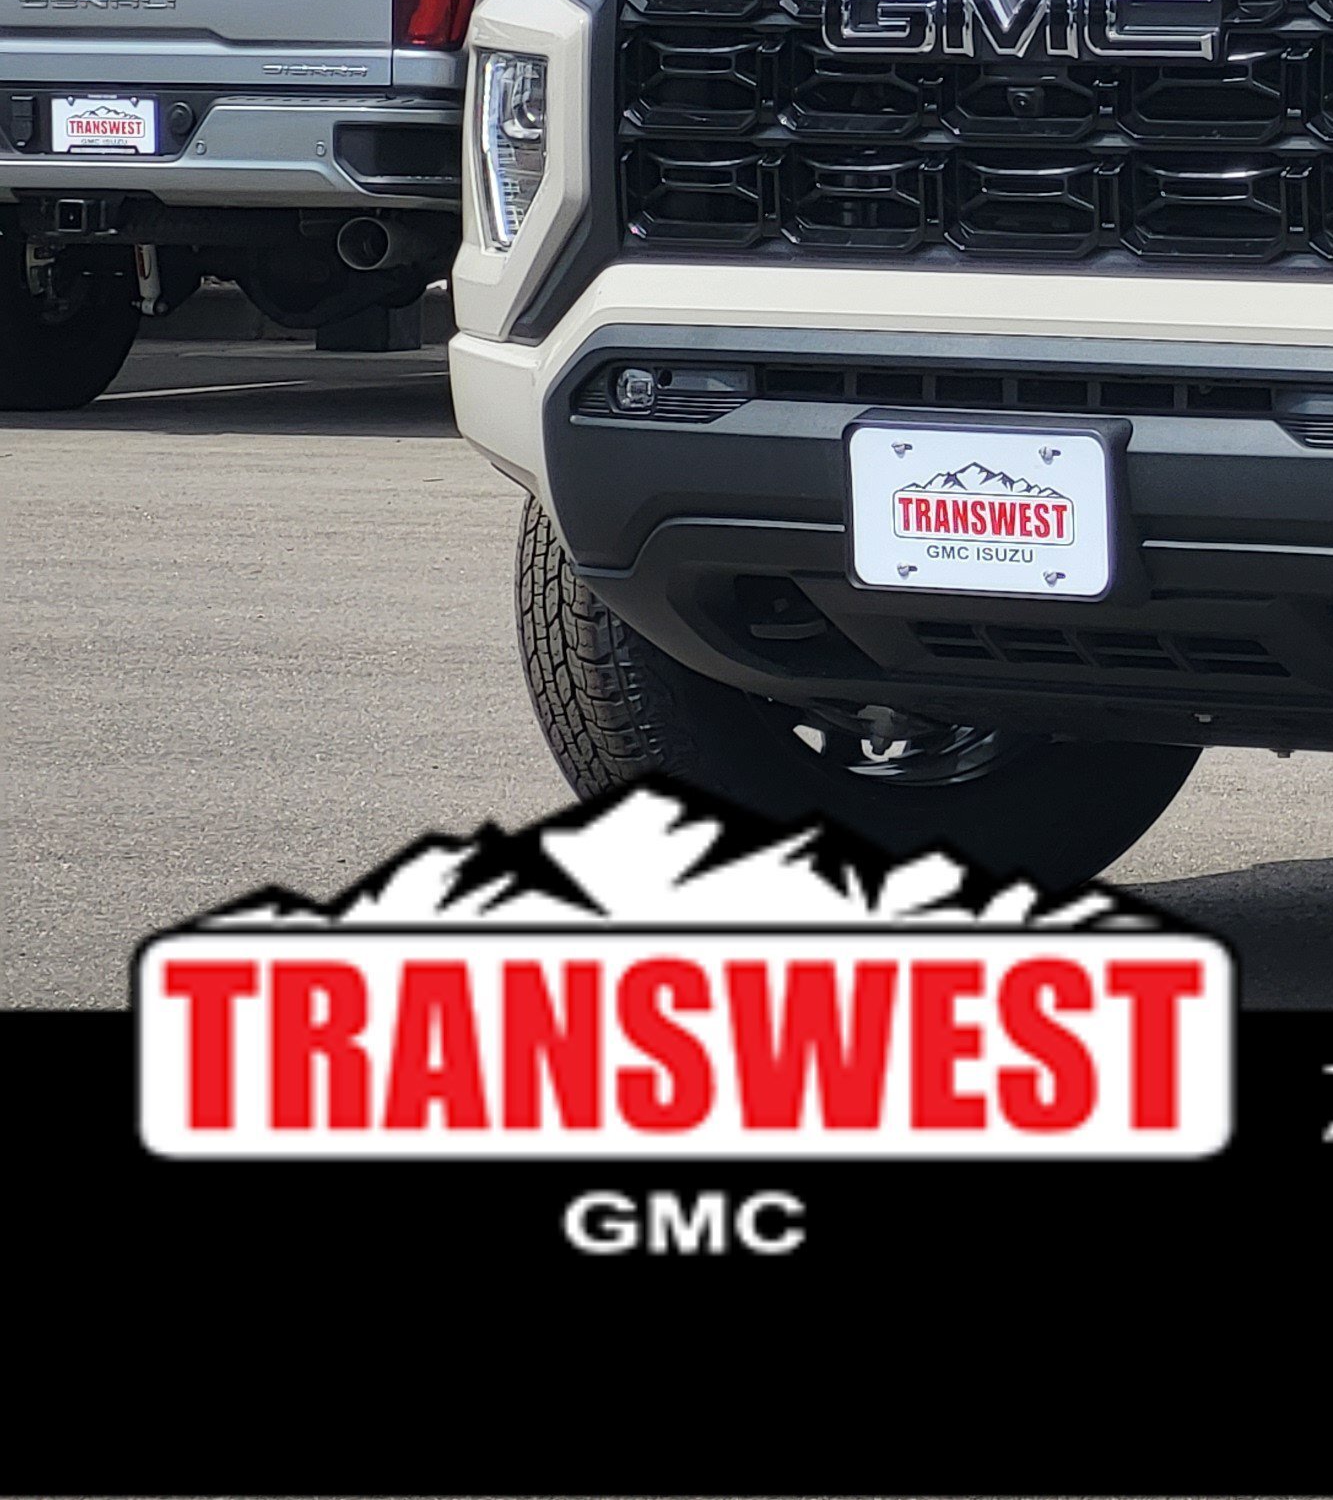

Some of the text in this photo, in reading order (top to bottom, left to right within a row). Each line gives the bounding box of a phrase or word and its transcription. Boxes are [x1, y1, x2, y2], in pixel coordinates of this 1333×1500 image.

[262, 63, 369, 78] SIERRA
[69, 120, 142, 135] TRANSWEST
[898, 497, 1068, 538] TRANSWEST
[926, 545, 1034, 563] GMC ISUZU
